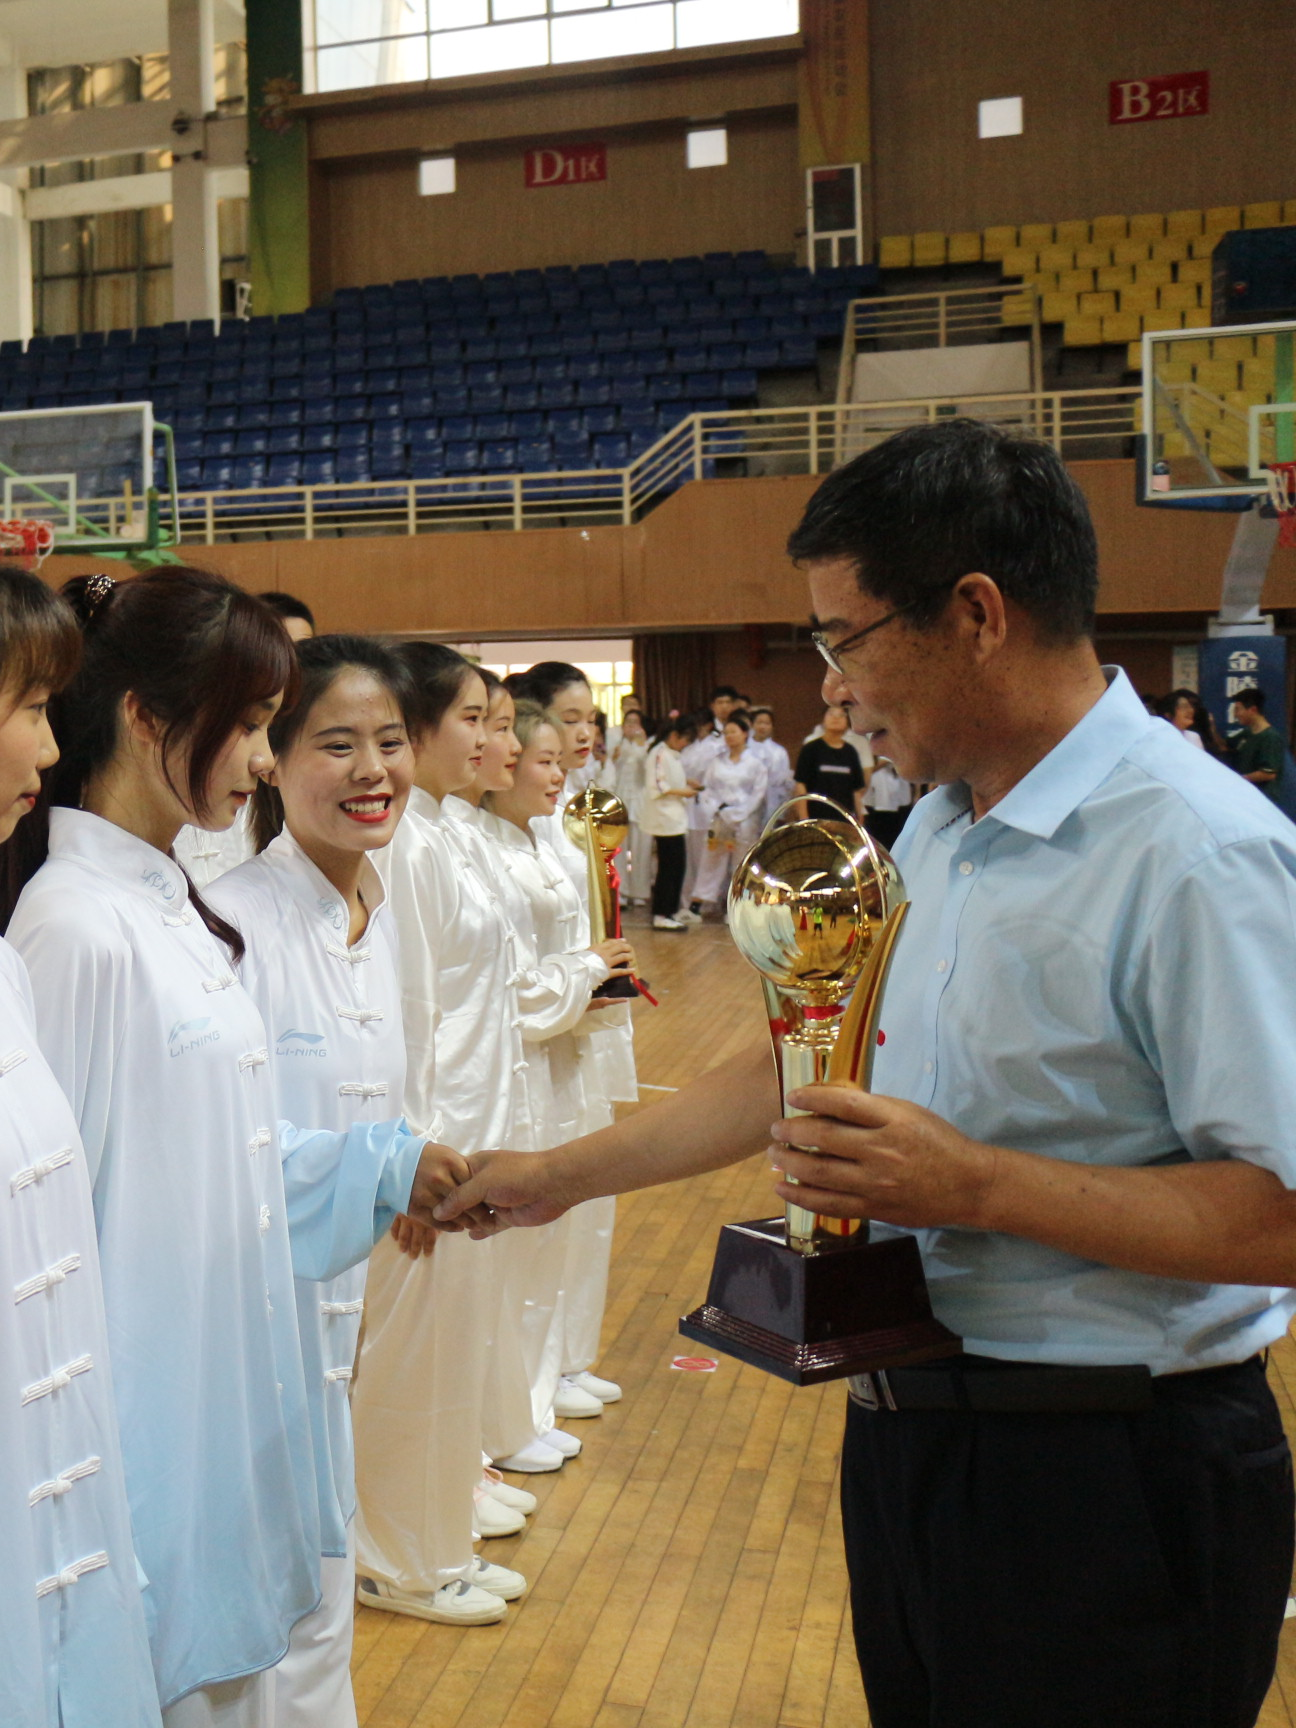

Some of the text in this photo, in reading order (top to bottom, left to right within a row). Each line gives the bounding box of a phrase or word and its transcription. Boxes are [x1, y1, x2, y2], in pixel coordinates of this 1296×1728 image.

[1116, 82, 1202, 119] B2区
[532, 149, 600, 184] D1区
[170, 1030, 221, 1058] LI-NING
[275, 1047, 328, 1058] LI-NING
